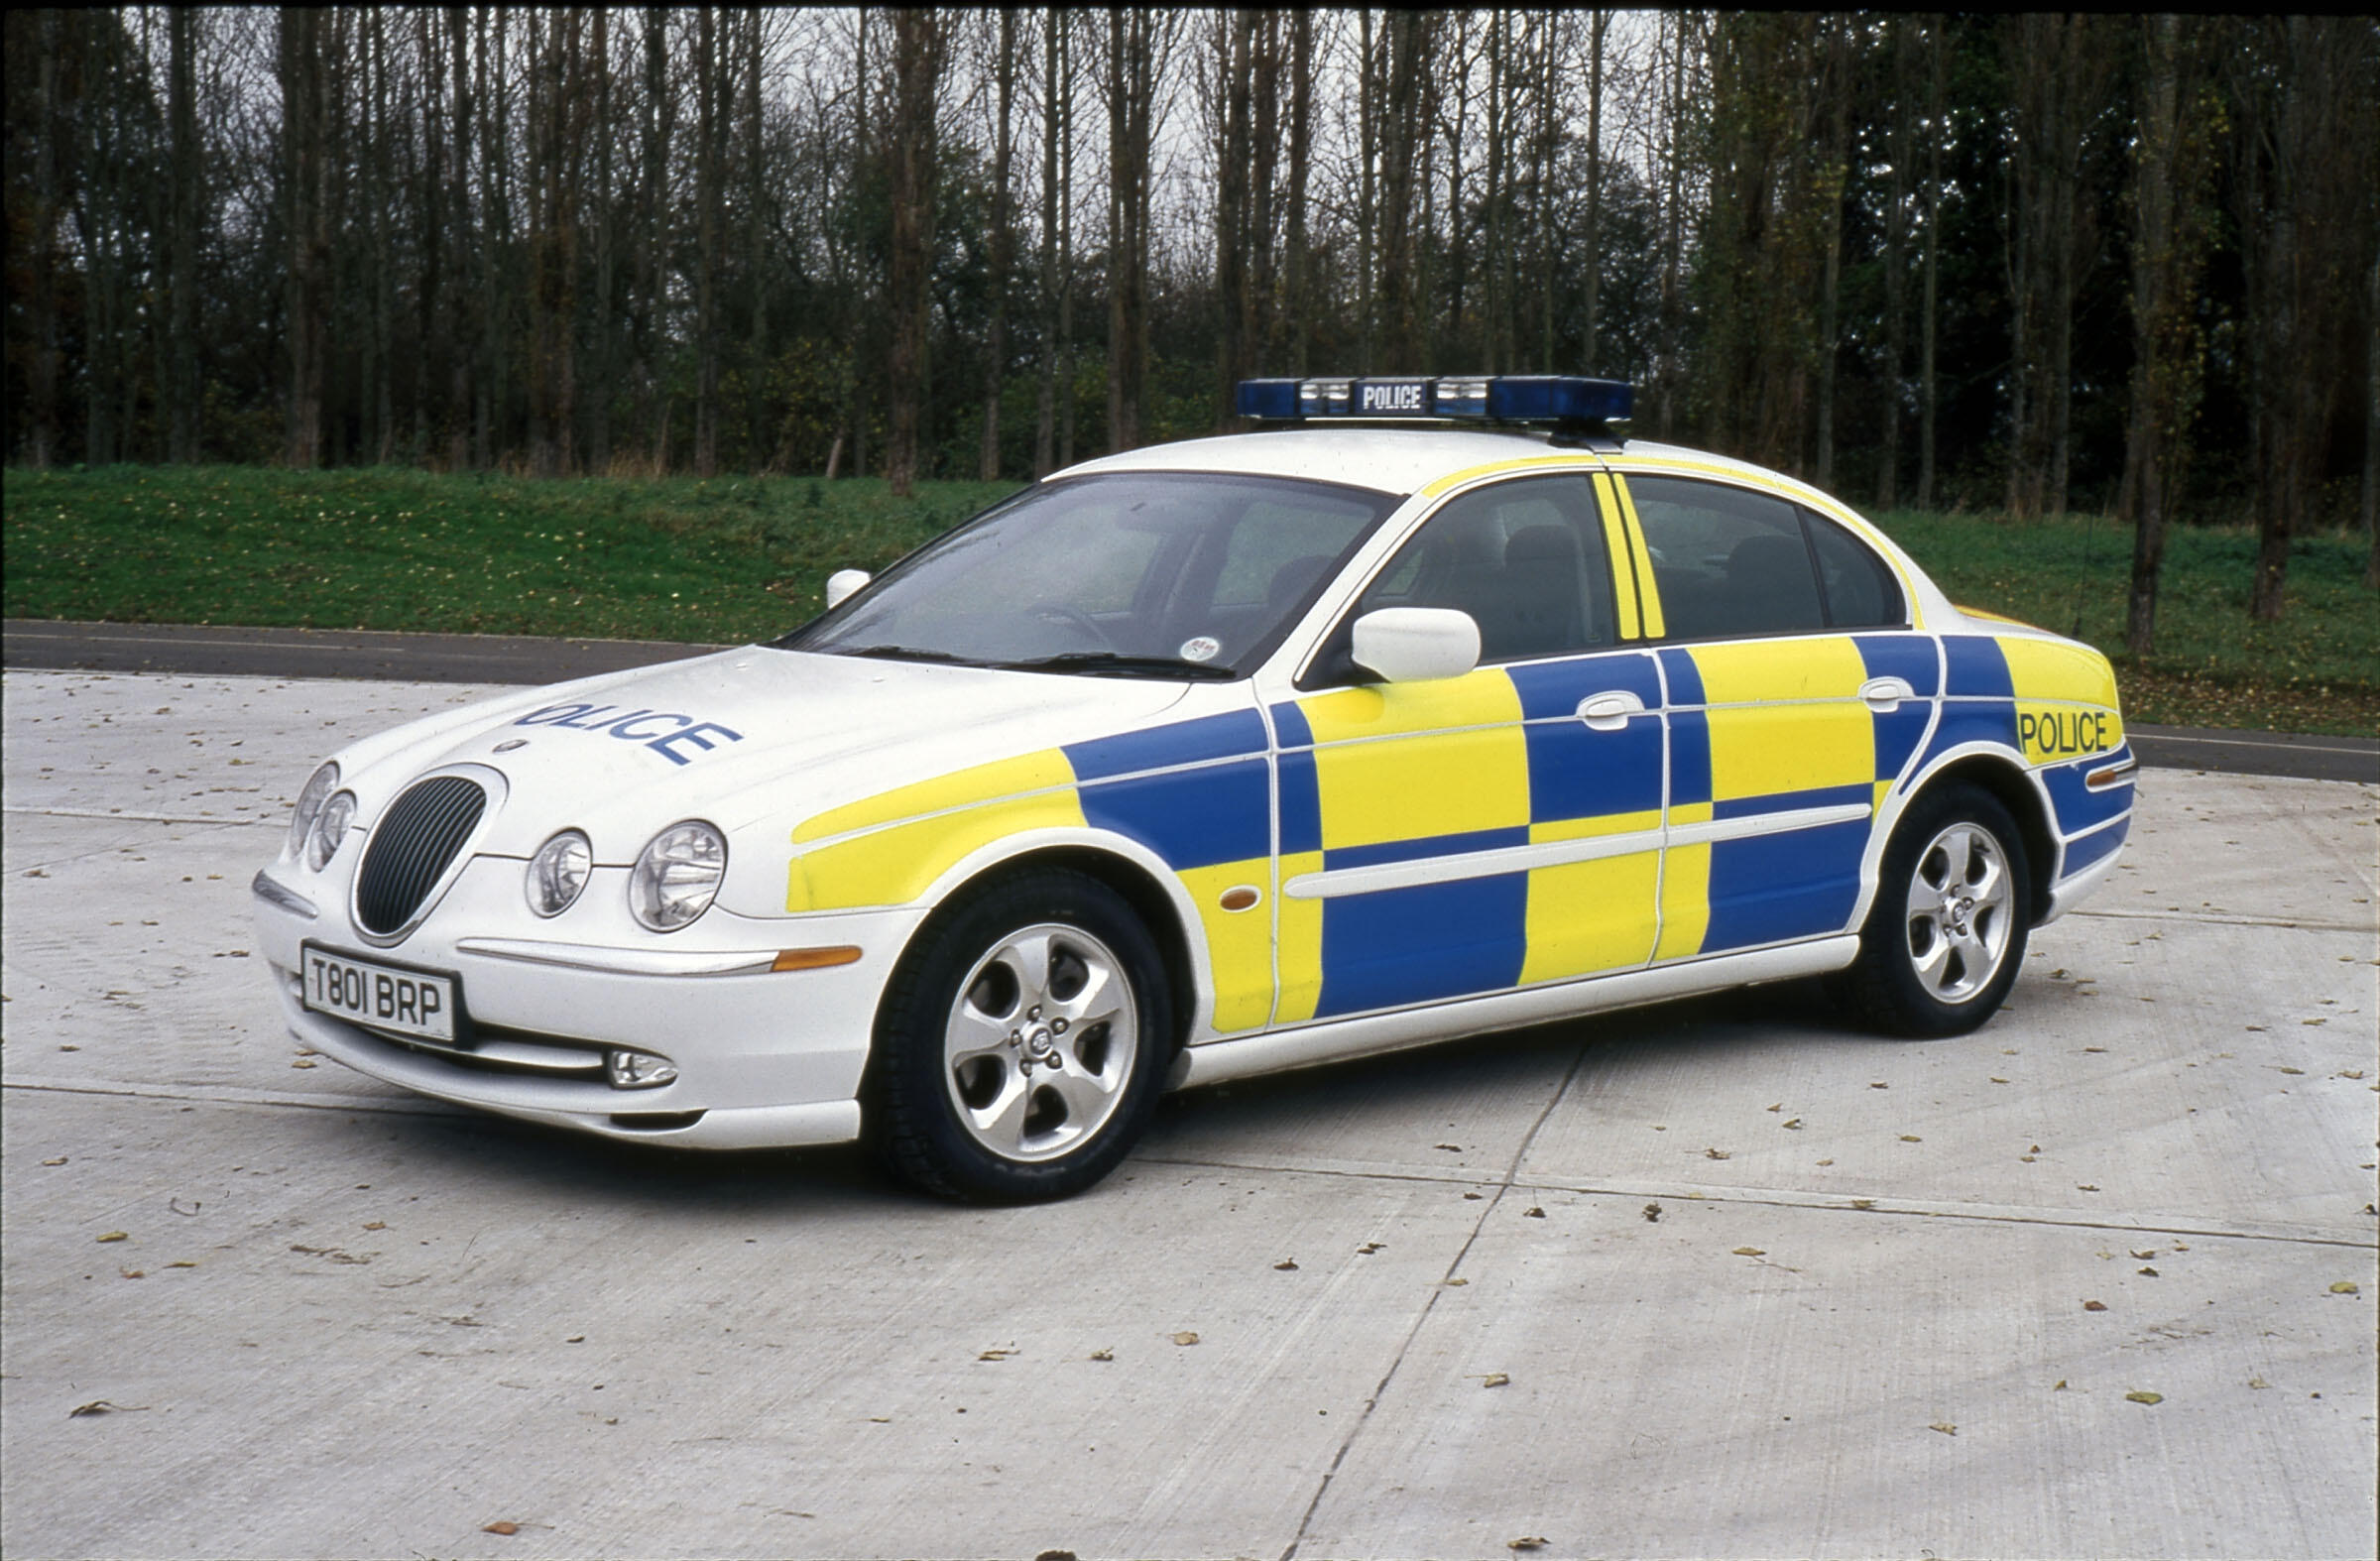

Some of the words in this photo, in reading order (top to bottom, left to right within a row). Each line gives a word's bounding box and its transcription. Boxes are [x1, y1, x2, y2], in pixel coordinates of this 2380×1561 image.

[1364, 385, 1421, 410] POLICE
[513, 704, 744, 766] OLICE
[2020, 711, 2107, 754] POLICE
[312, 957, 368, 1015] T801
[376, 974, 440, 1025] BRP
